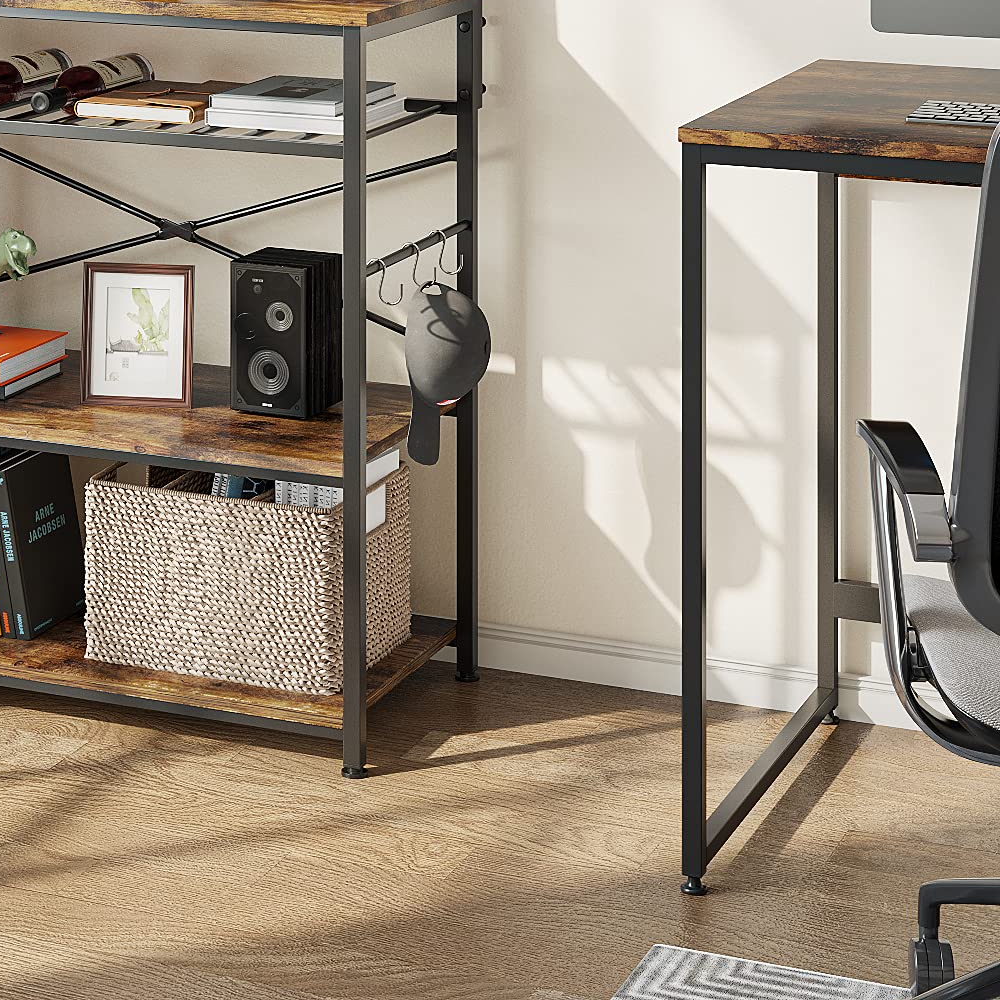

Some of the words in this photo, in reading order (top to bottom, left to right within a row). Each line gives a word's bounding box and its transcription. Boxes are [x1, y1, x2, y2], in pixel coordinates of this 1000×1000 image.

[0, 511, 9, 528] ARNE
[35, 502, 55, 522] ARNE
[28, 513, 66, 544] JACOBSEN
[3, 529, 14, 562] JACOBSEN
